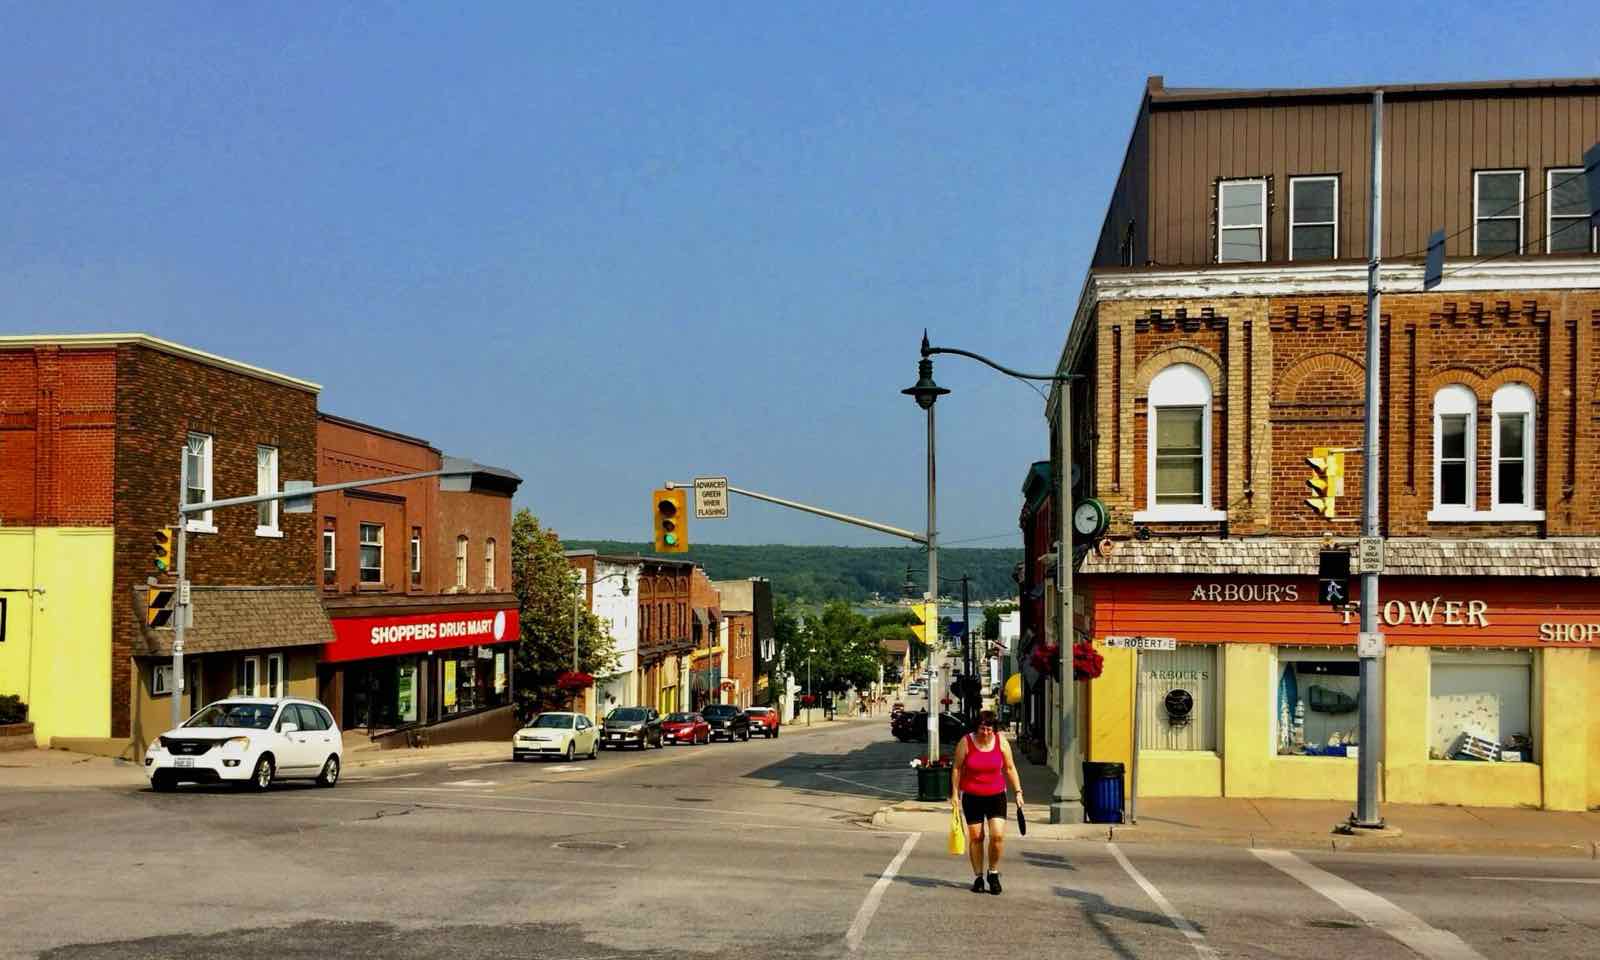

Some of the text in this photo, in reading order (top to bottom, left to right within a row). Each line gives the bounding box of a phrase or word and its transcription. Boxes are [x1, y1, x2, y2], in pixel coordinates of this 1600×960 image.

[1190, 583, 1299, 602] ARBOUR'S
[1342, 597, 1489, 627] FOWER
[370, 619, 493, 645] SHOPPERS DRUG MART
[1539, 623, 1600, 642] SHOP
[1123, 638, 1161, 648] ROBERT
[1149, 669, 1209, 681] ARBOUR'S
